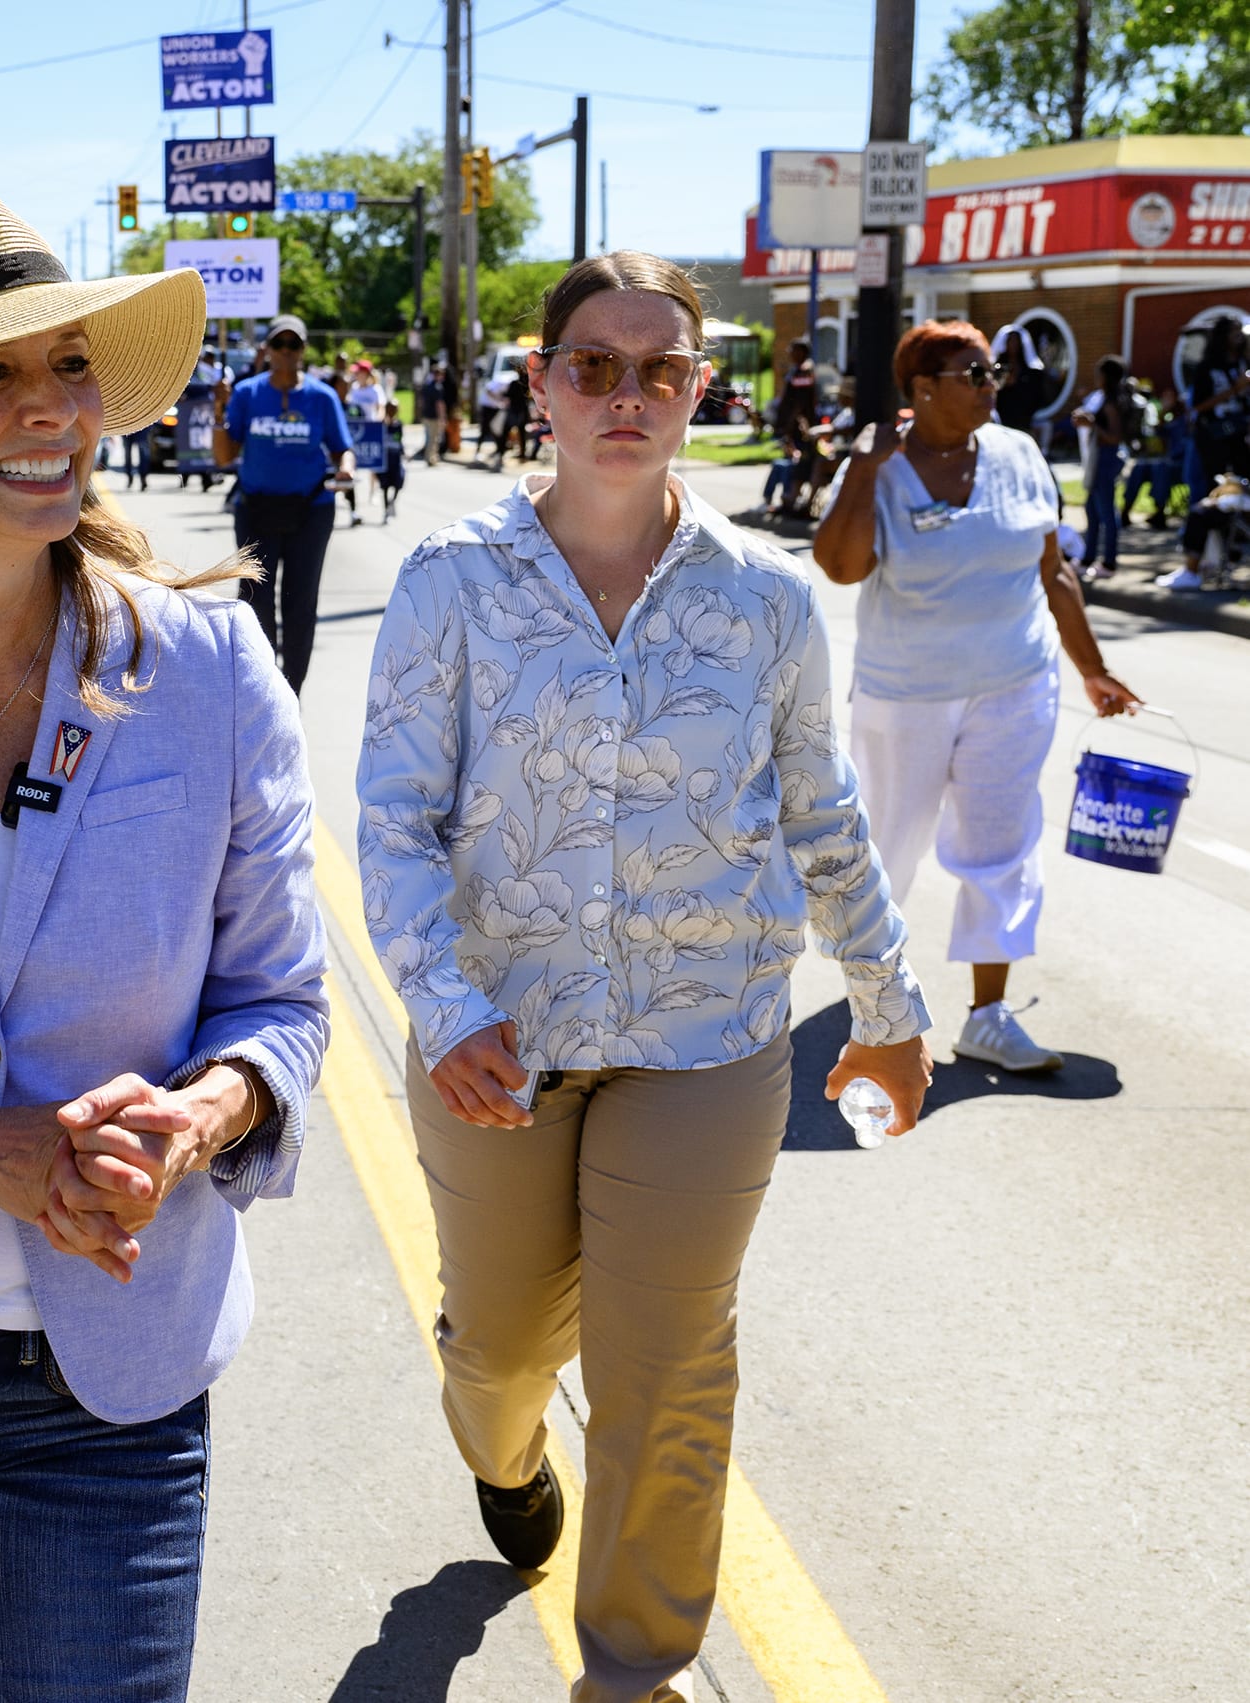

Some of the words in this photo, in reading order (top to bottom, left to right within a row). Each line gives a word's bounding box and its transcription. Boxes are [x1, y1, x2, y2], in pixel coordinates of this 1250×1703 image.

[171, 77, 265, 102] ACTON
[171, 138, 270, 167] CLEVELAND
[869, 152, 889, 172] DO
[893, 152, 920, 172] NOT
[170, 181, 273, 205] ACTON
[870, 175, 919, 197] BLOCK
[938, 200, 1057, 264] BOAT
[198, 267, 263, 284] CTON
[15, 785, 51, 802] RØDE
